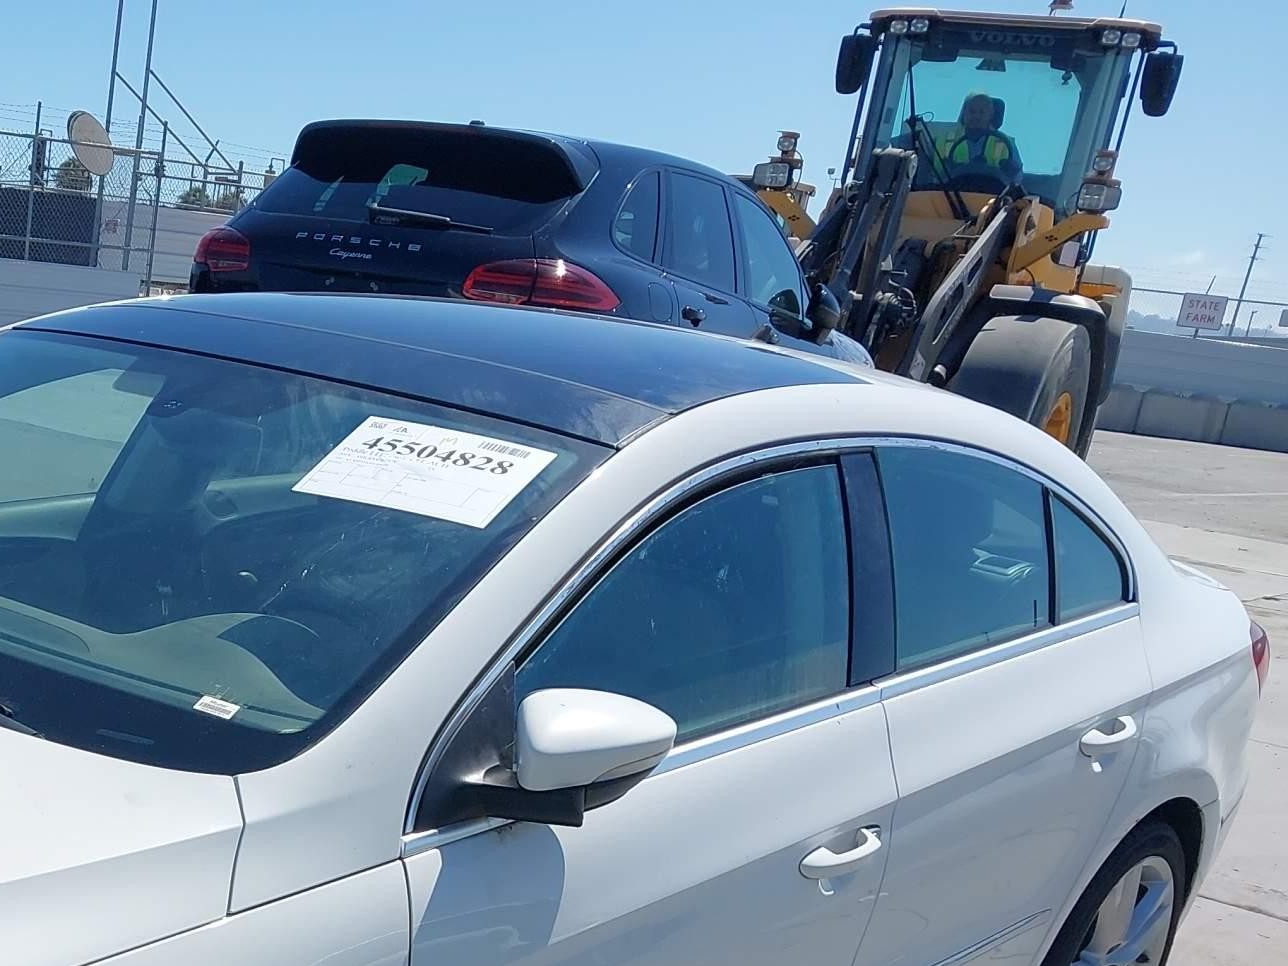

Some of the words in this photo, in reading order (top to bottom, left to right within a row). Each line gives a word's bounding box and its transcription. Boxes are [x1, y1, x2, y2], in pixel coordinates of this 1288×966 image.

[968, 31, 1055, 47] VOLVO
[295, 231, 422, 252] PORSCHE
[329, 247, 372, 260] Cayenne
[1187, 300, 1220, 311] STATE
[1185, 312, 1216, 324] FARM
[362, 436, 514, 475] 45504828
